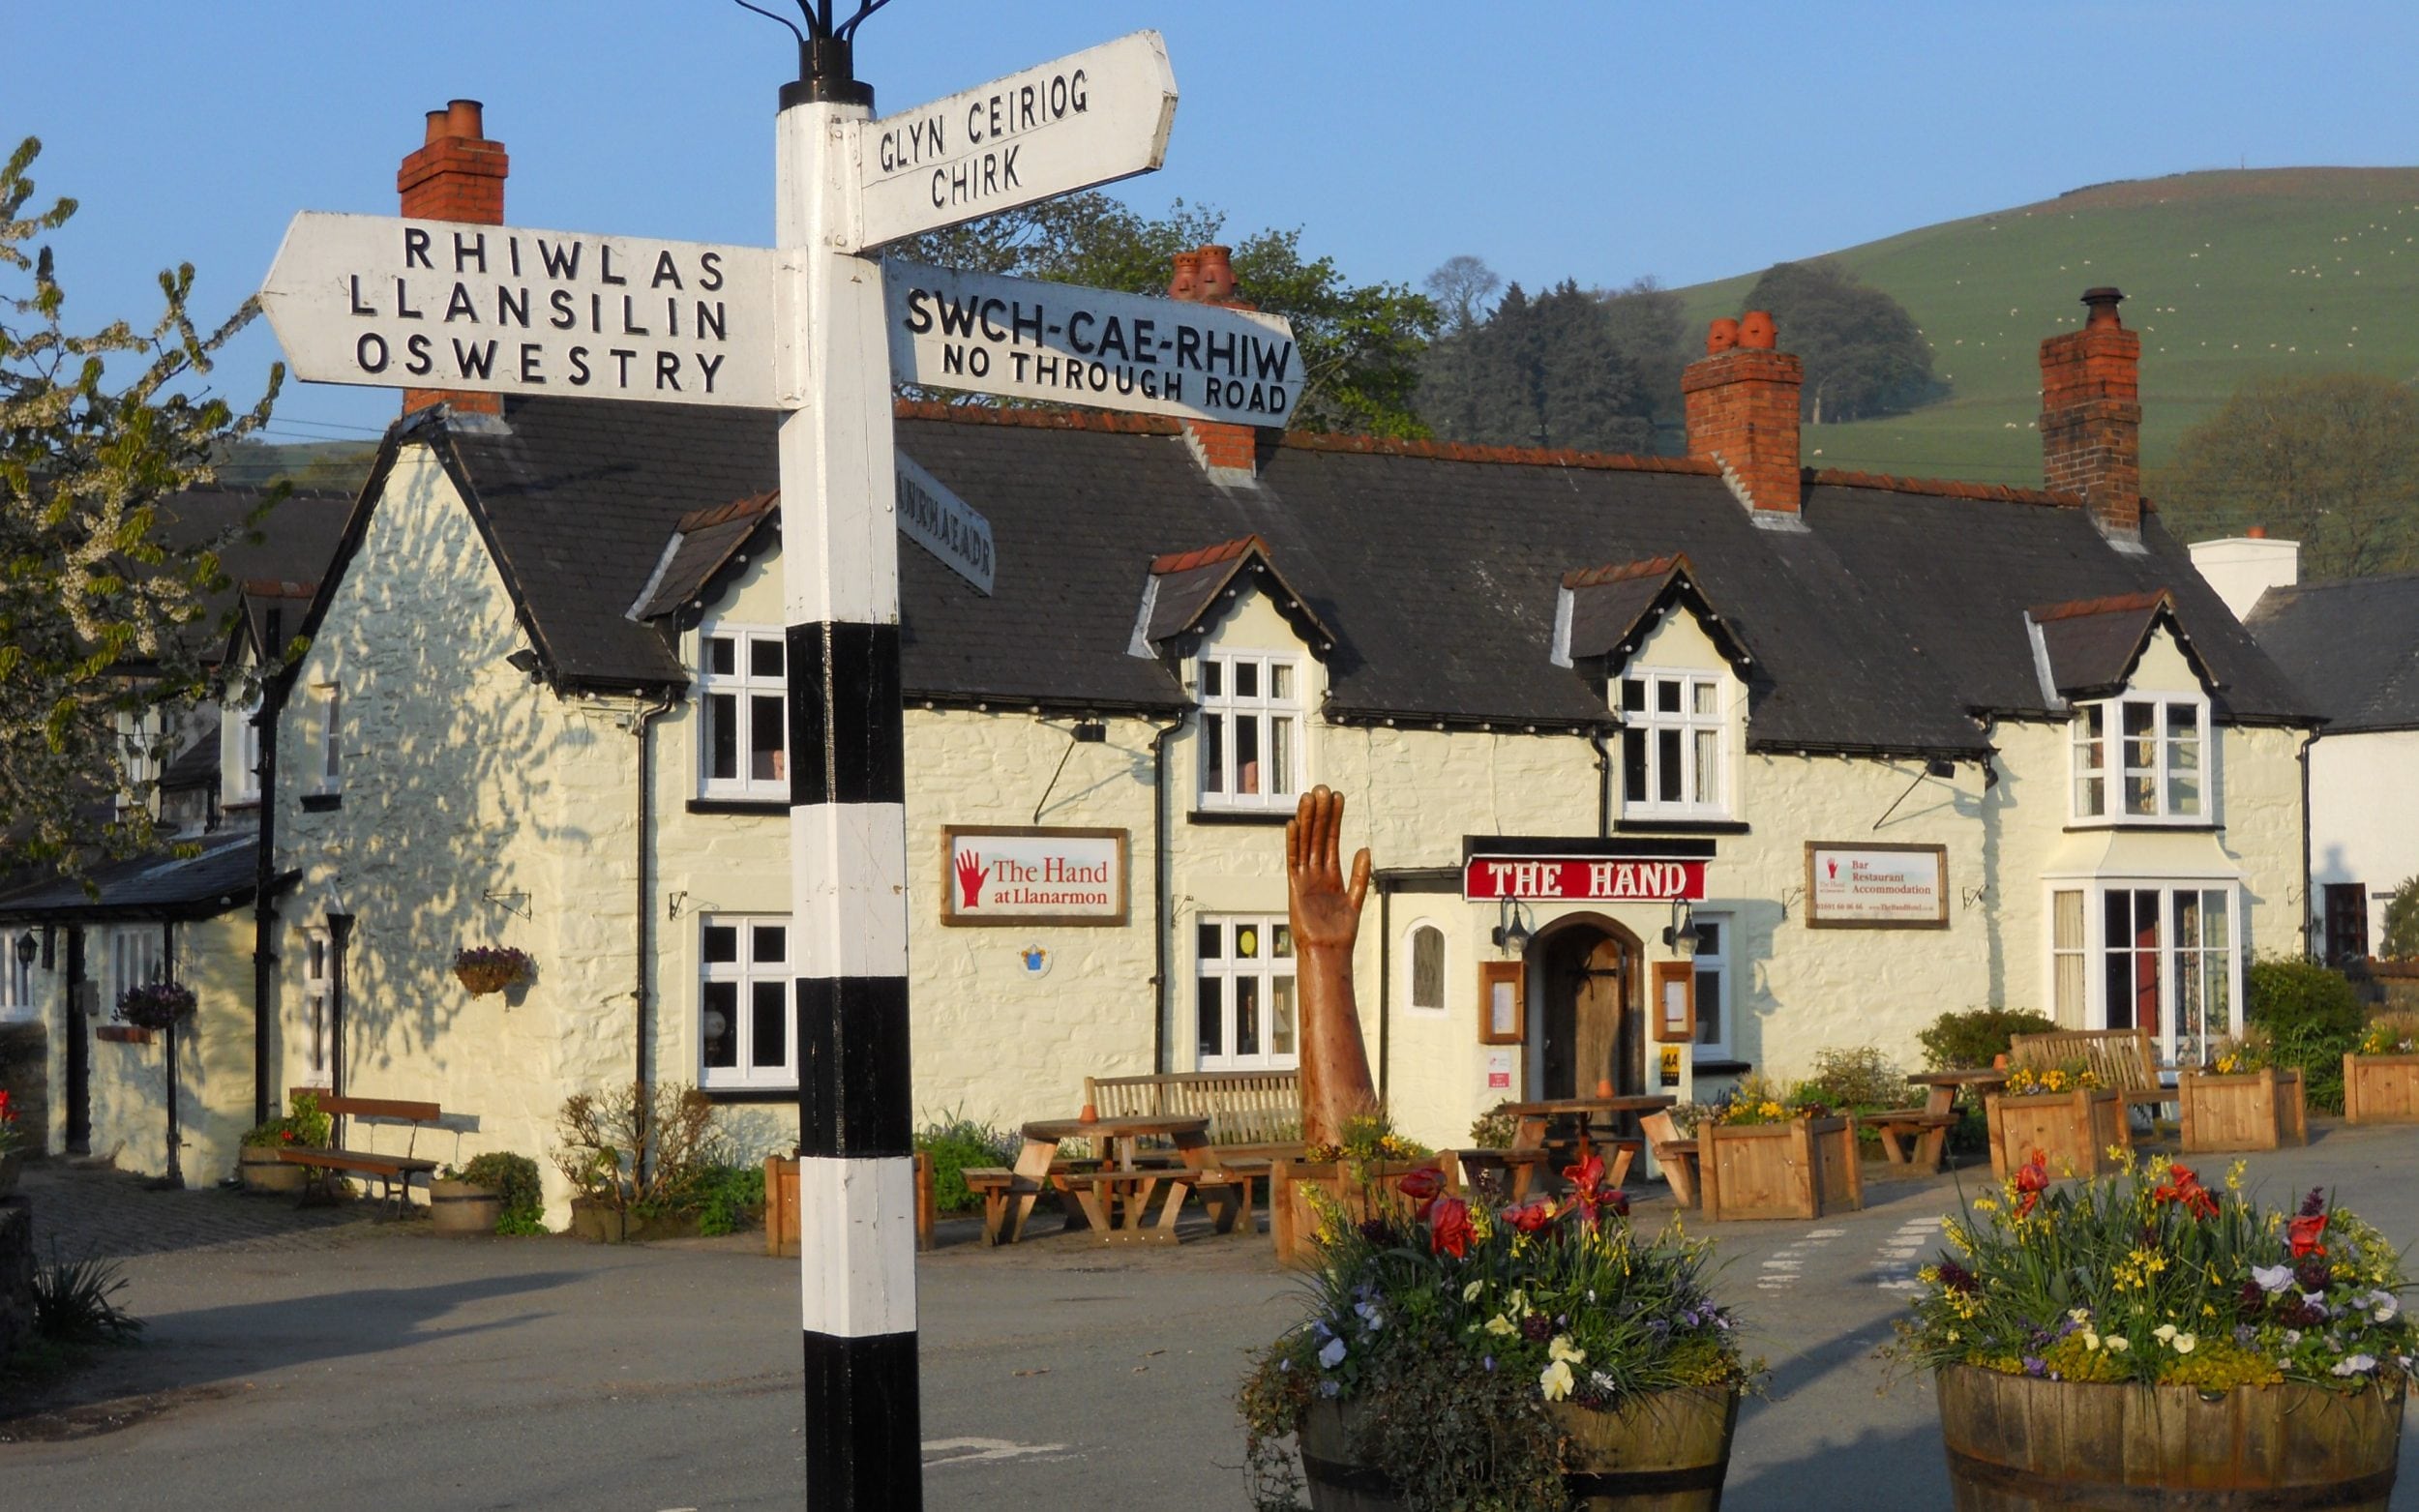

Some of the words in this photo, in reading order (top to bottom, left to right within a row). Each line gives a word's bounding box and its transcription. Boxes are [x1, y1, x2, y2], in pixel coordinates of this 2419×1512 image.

[881, 115, 945, 172] GLYN
[969, 69, 1089, 144] CEIRIOG
[932, 144, 1022, 208] CHIRK
[404, 227, 723, 291] RHIWLAS
[349, 274, 727, 341] LLANSILIN
[904, 288, 1292, 383] SWCH-CAE-RHIW
[356, 332, 725, 394] OSWESTRY
[942, 343, 990, 377] NO
[1010, 351, 1182, 401] THROUGH
[1206, 377, 1286, 414] ROAD
[993, 859, 1038, 883] The
[1043, 857, 1108, 883] Hand
[1488, 862, 1563, 898] THE
[1589, 862, 1687, 898] HAND
[1852, 860, 1869, 870] Bar
[1852, 873, 1904, 882] Restaurant
[995, 890, 1010, 904] at
[1013, 888, 1108, 904] Llanarmon
[1852, 885, 1931, 895] Accommodation
[1663, 1052, 1678, 1067] AA
